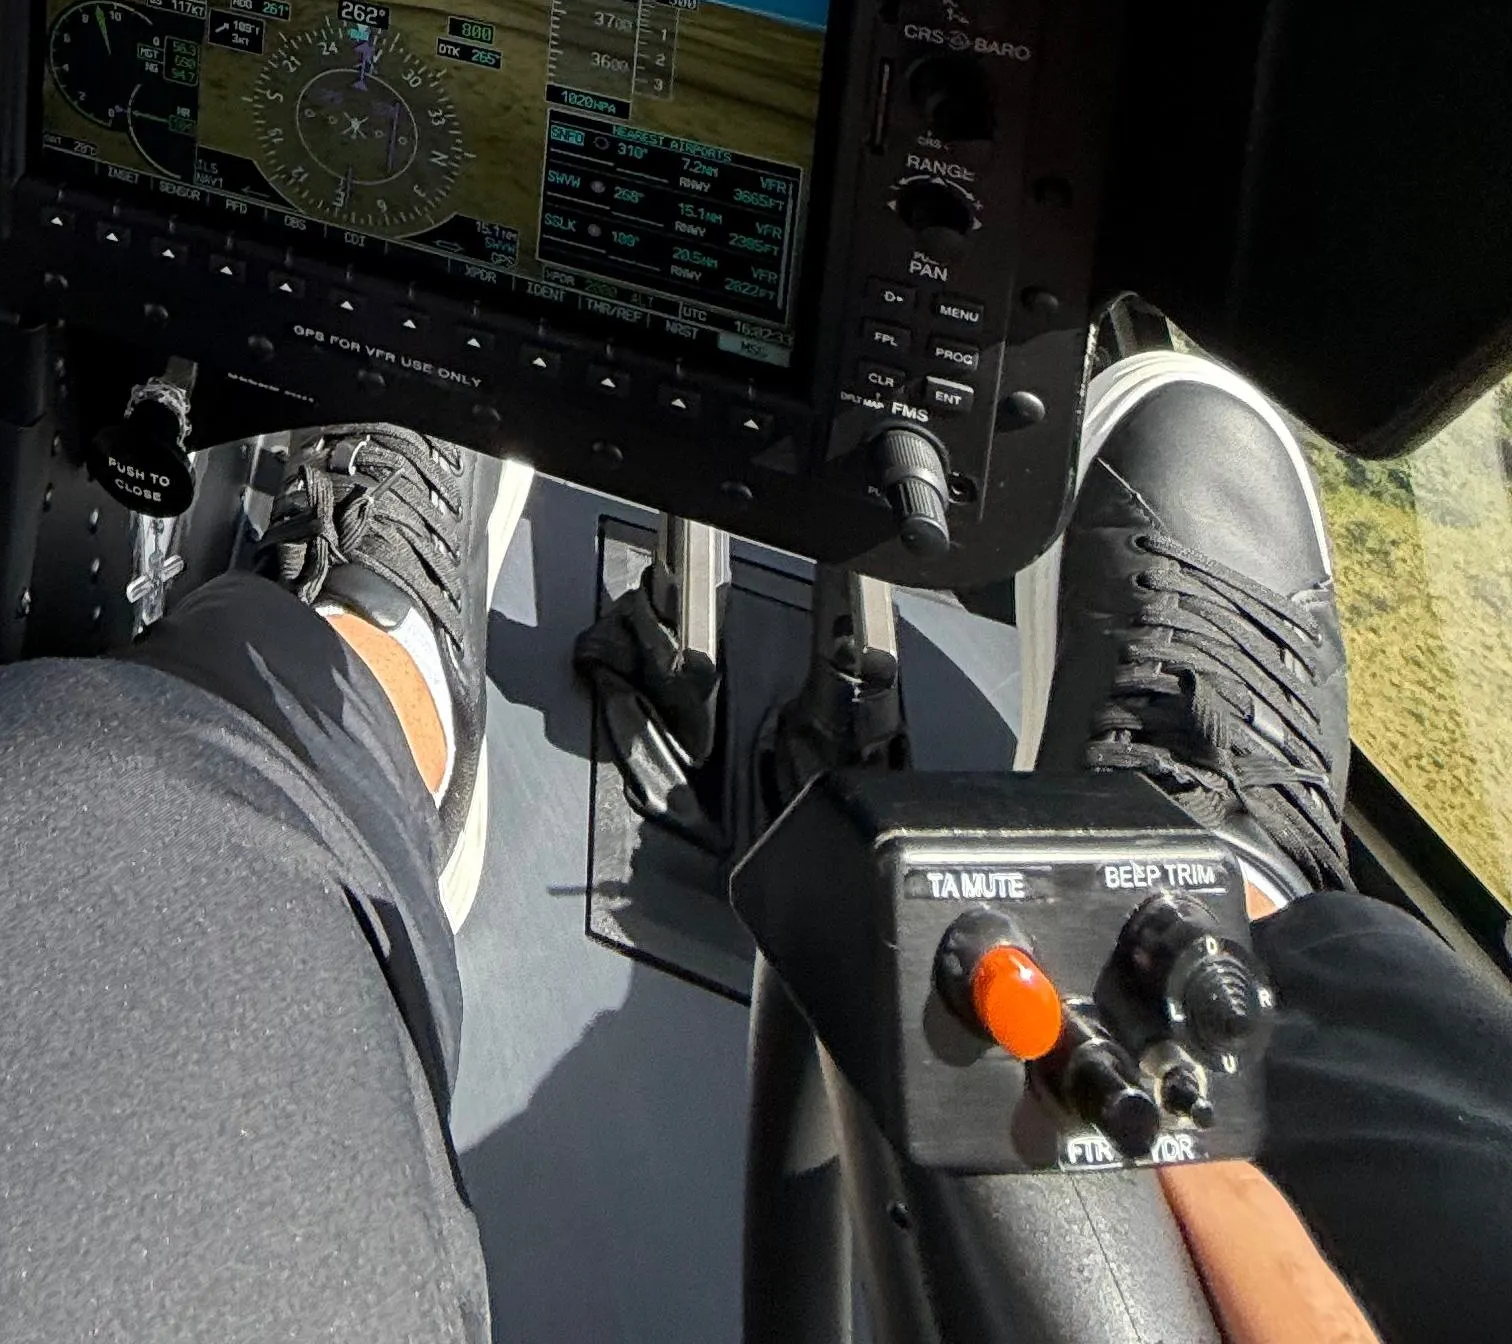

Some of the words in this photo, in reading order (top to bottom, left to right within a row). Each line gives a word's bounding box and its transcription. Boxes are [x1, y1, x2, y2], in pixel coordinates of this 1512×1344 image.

[110, 11, 122, 22] 10
[341, 1, 386, 24] 262°
[461, 22, 492, 40] 800
[320, 40, 338, 56] 24
[439, 44, 460, 57] DTK
[974, 37, 1032, 62] BARO
[402, 70, 422, 88] 30
[428, 108, 445, 126] 33
[612, 125, 664, 147] NEAREST
[670, 138, 732, 161] AIRPORTS
[108, 167, 137, 184] INSET
[904, 152, 977, 183] RANGE
[159, 179, 200, 200] SENSOR
[759, 176, 787, 194] VFR
[755, 222, 783, 239] VFR
[750, 265, 778, 283] VFR
[908, 258, 949, 283] PAN
[526, 282, 567, 303] IDENT
[586, 297, 642, 323] THR/REF
[939, 303, 980, 324] MENU
[293, 324, 326, 342] GPS
[330, 334, 363, 355] FOR
[366, 344, 398, 367] VFR
[399, 354, 434, 375] USE
[437, 363, 483, 389] ONLY
[935, 345, 973, 367] PROC
[867, 372, 895, 389] CLR
[936, 390, 962, 407] ENT
[890, 401, 929, 423] FMS
[108, 456, 145, 482] PUSH
[149, 471, 171, 488] TO
[114, 477, 162, 503] CLOSE
[926, 872, 959, 897] TA
[960, 872, 1025, 899] MUTE
[1104, 863, 1161, 889] BEEP
[1164, 861, 1216, 887] TRIM
[1256, 985, 1273, 1008] R
[1169, 1001, 1185, 1021] L
[1221, 1053, 1236, 1074] U
[1067, 1136, 1114, 1164] FTR
